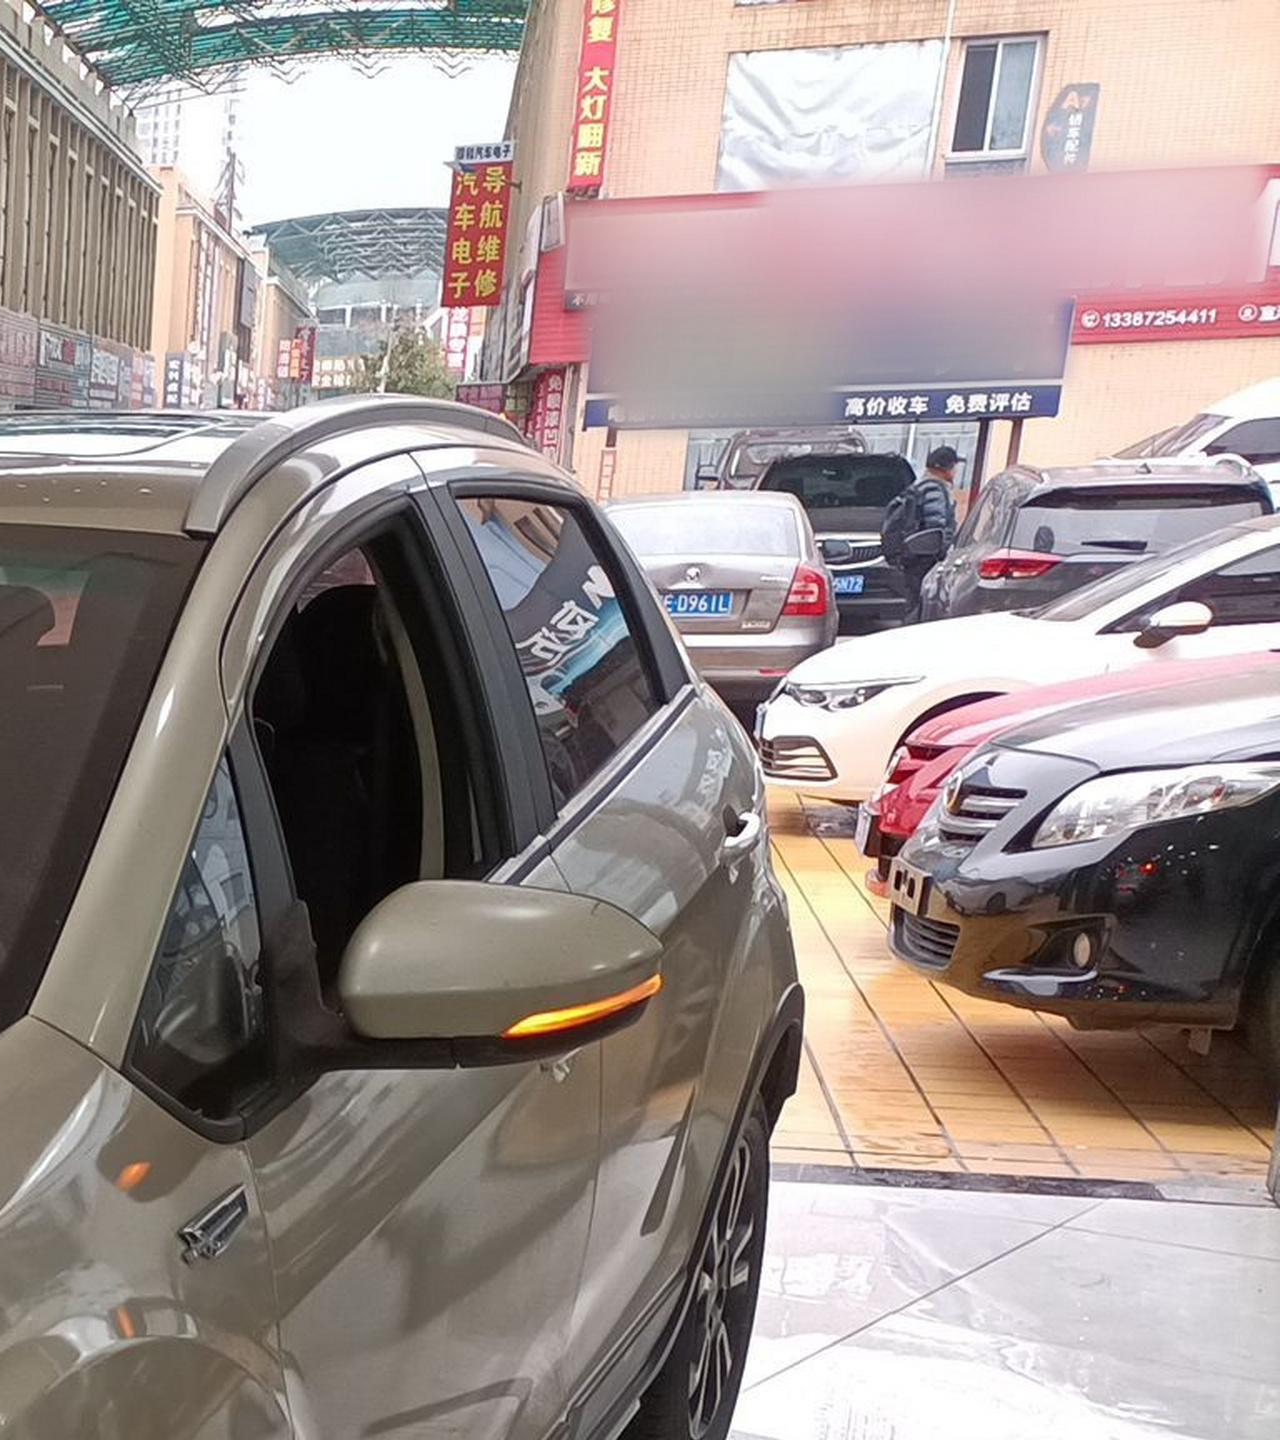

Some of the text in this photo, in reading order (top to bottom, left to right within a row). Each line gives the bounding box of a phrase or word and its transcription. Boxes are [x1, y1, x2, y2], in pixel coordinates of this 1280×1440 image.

[447, 169, 480, 299] 汽车电子
[474, 166, 505, 298] 导航维修
[1102, 308, 1216, 328] 13387254411
[844, 391, 1033, 417] 高价收车 免费评估
